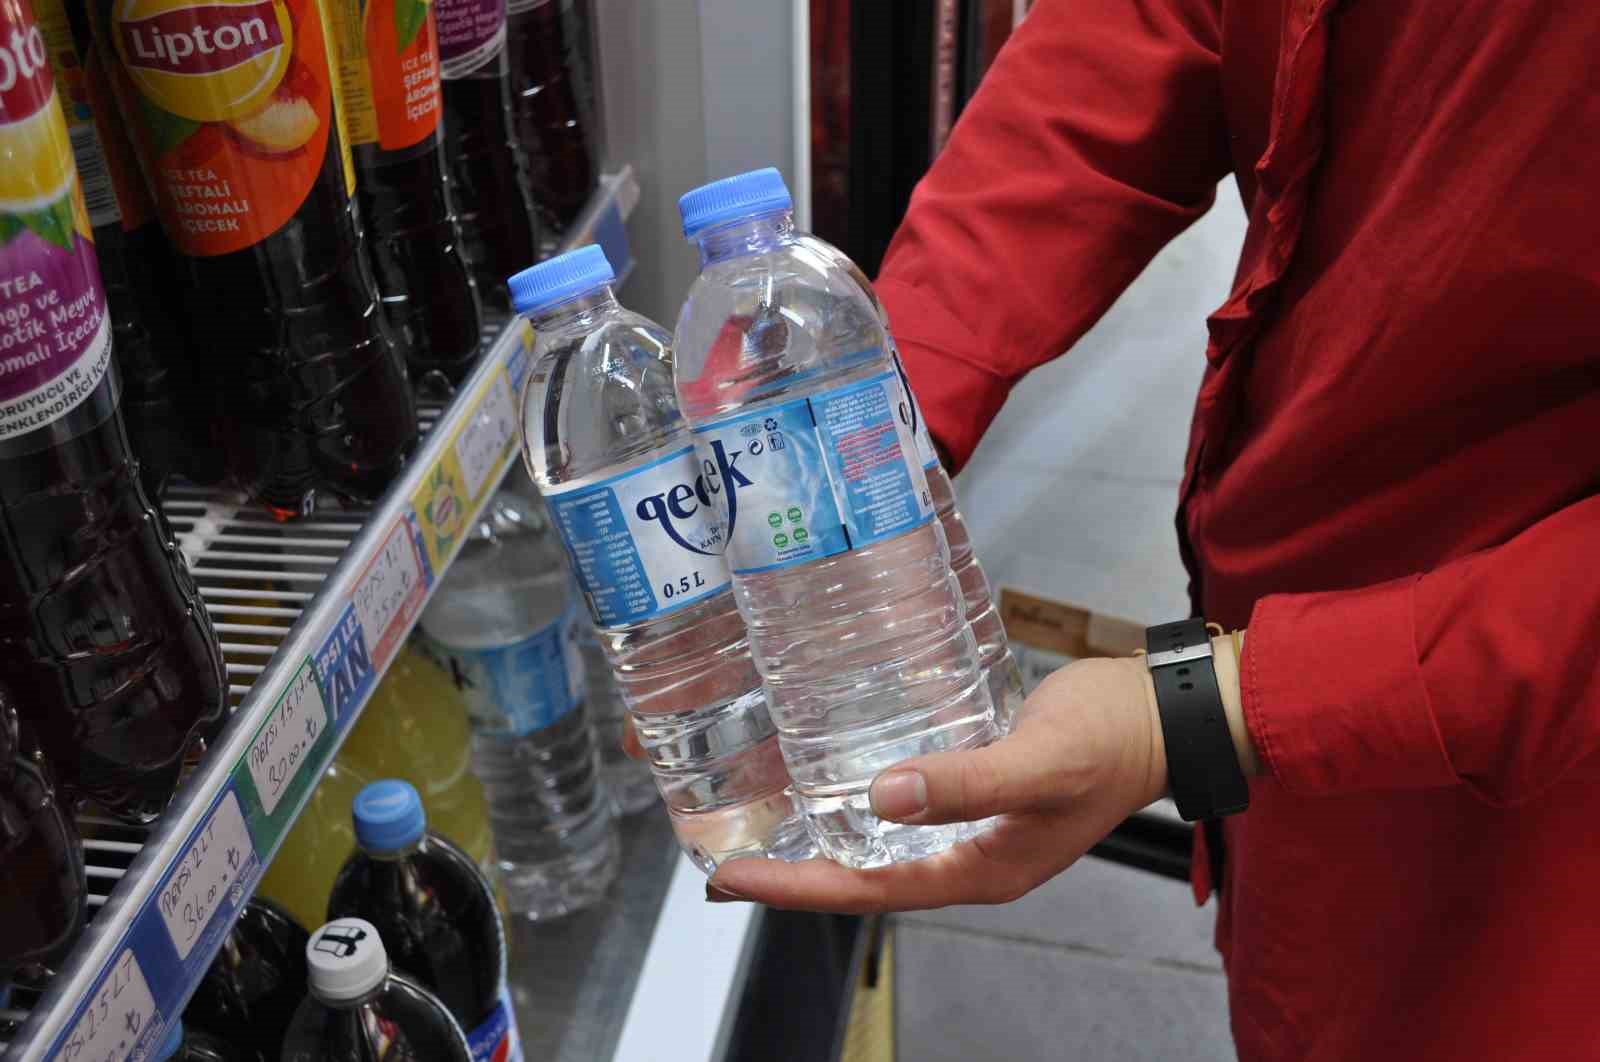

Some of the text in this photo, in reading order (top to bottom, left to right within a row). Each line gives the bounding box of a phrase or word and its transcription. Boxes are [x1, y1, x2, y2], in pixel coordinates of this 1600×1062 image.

[132, 17, 268, 65] Lipton
[188, 168, 218, 182] TEA
[0, 271, 43, 299] TEA
[36, 289, 61, 310] ve
[50, 286, 97, 329] Meyve
[67, 367, 83, 385] VE
[663, 571, 706, 598] 0.5 L
